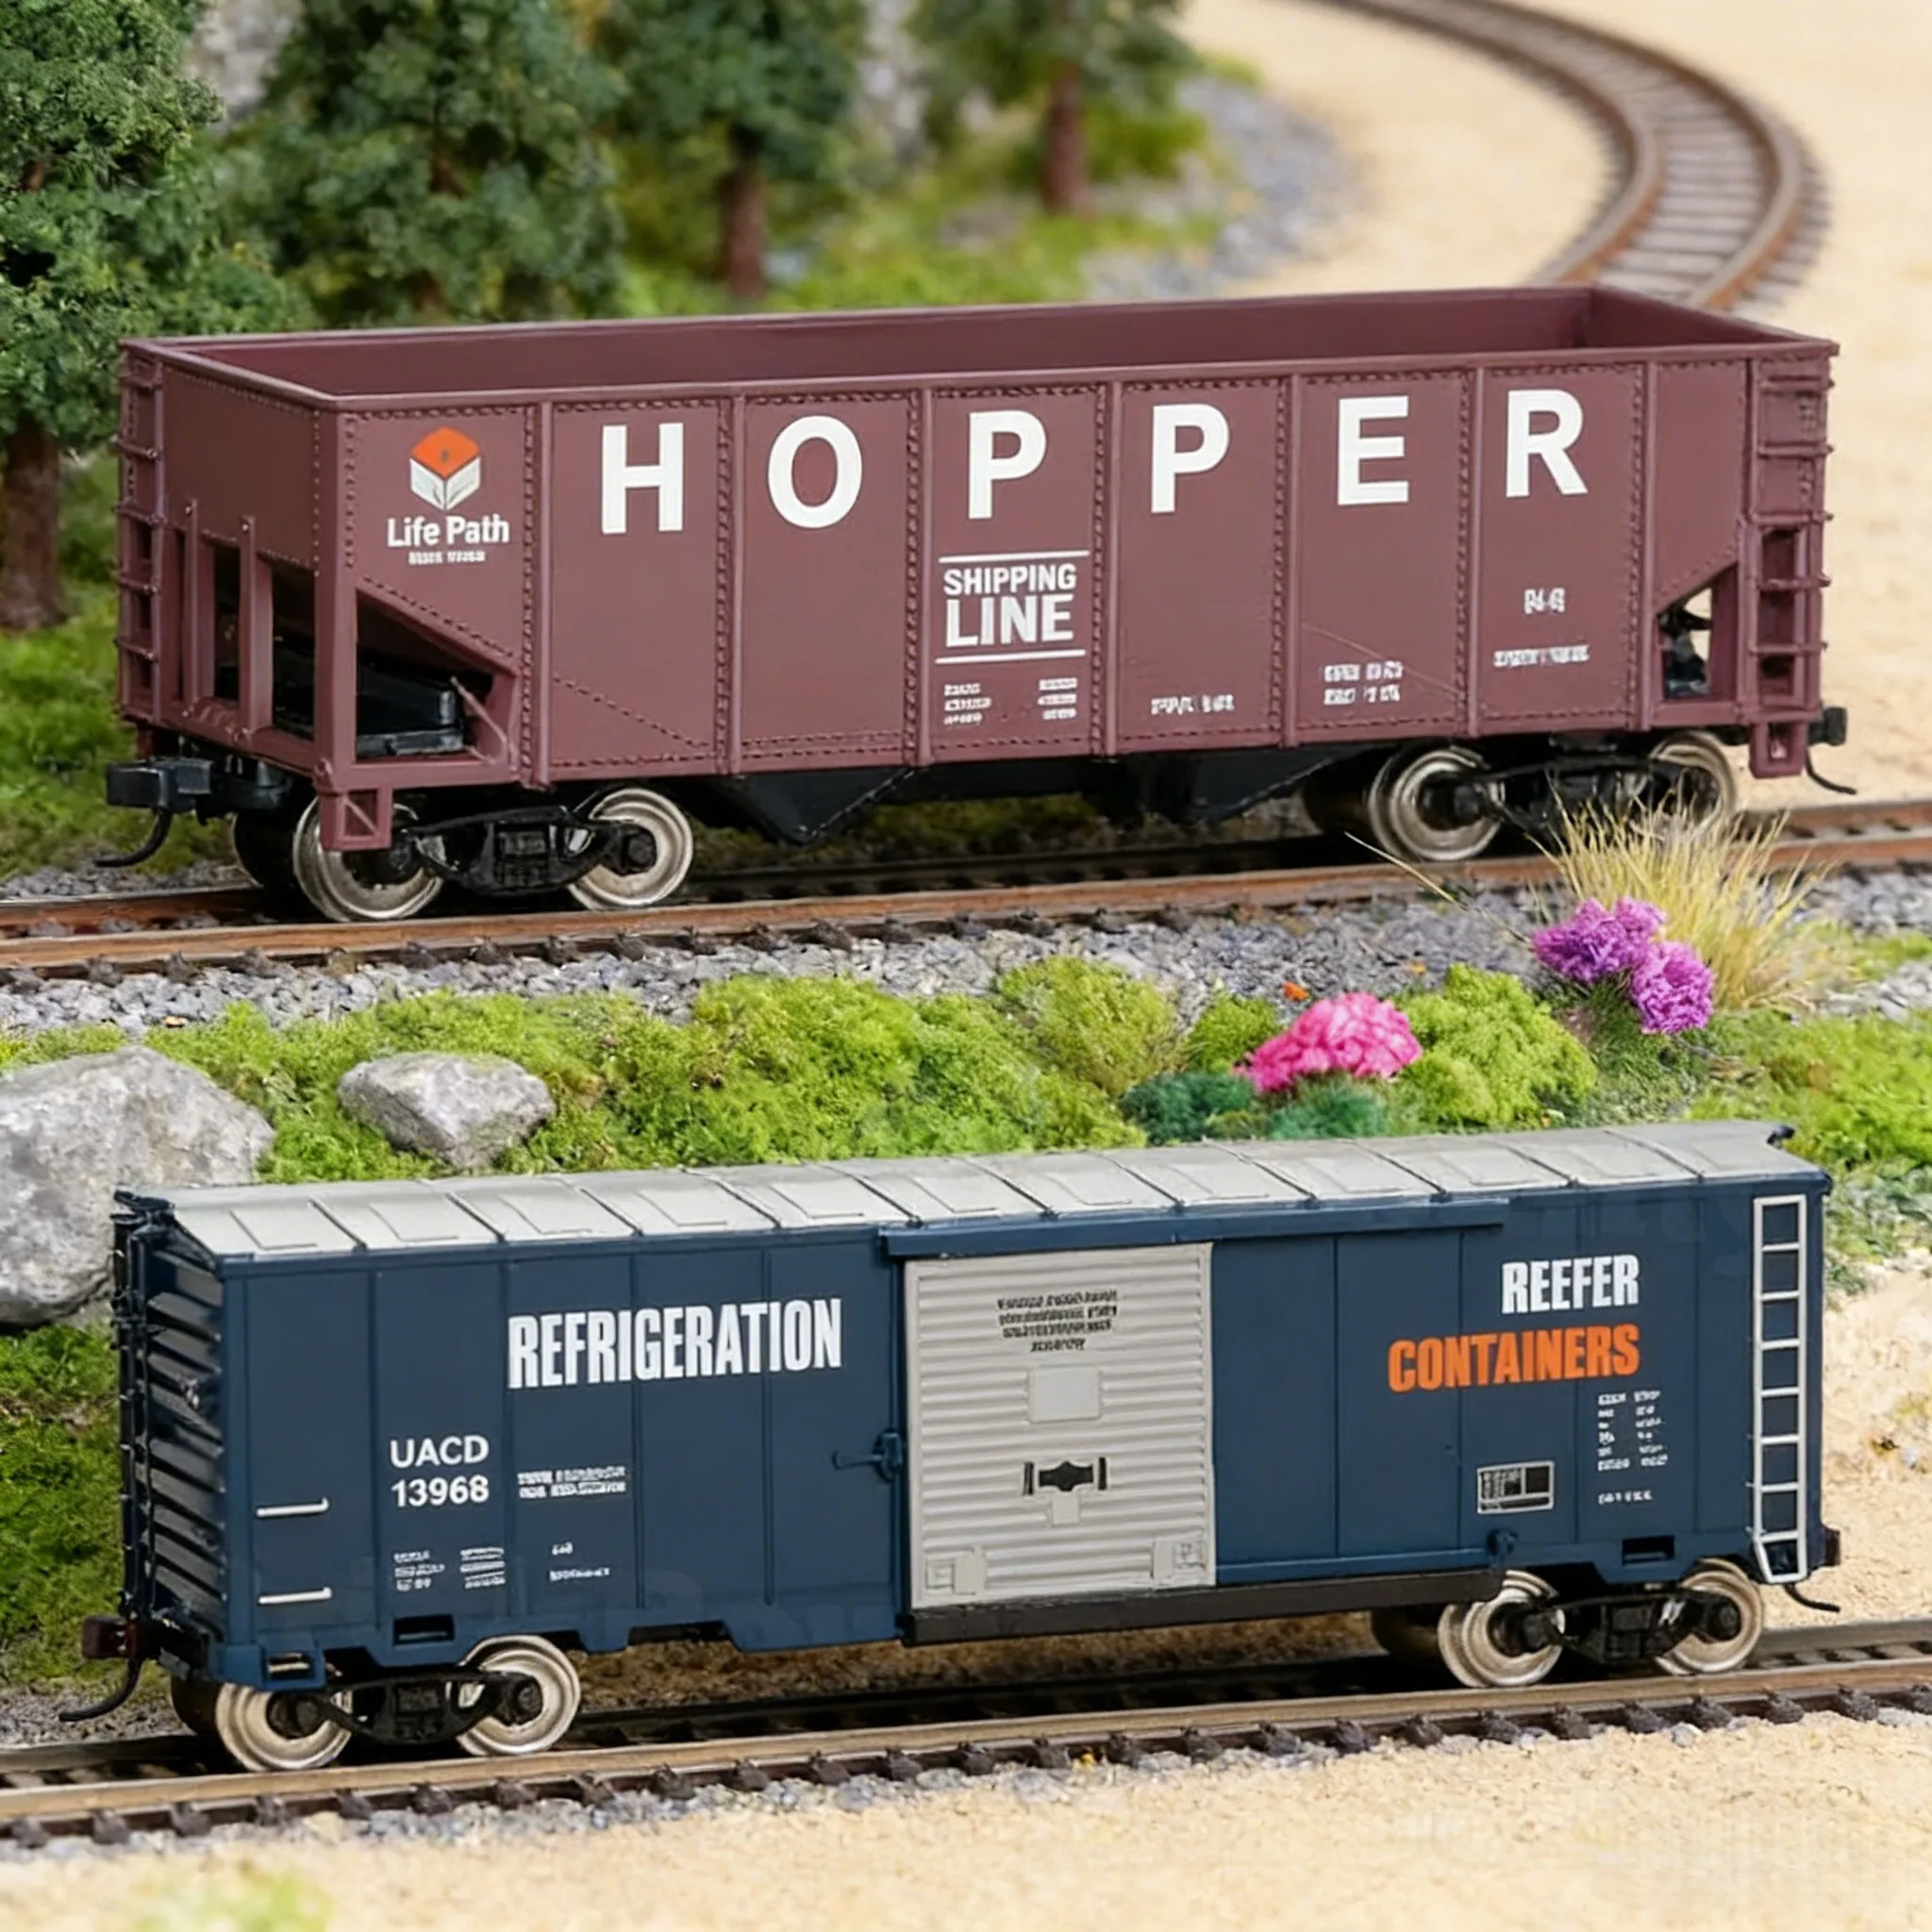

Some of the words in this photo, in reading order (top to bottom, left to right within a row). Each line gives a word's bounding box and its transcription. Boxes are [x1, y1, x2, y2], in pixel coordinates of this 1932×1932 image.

[601, 389, 1589, 534] HOPPER
[387, 515, 441, 547] Life
[445, 512, 510, 544] Path
[943, 563, 1077, 596] SHIPPING
[945, 593, 1074, 647] LINE
[1502, 1255, 1640, 1314] REEFER
[508, 1298, 841, 1389] REFRIGERATION
[1389, 1324, 1640, 1392] CONTAINERS
[390, 1435, 490, 1469] UACD
[391, 1474, 490, 1507] 13968
